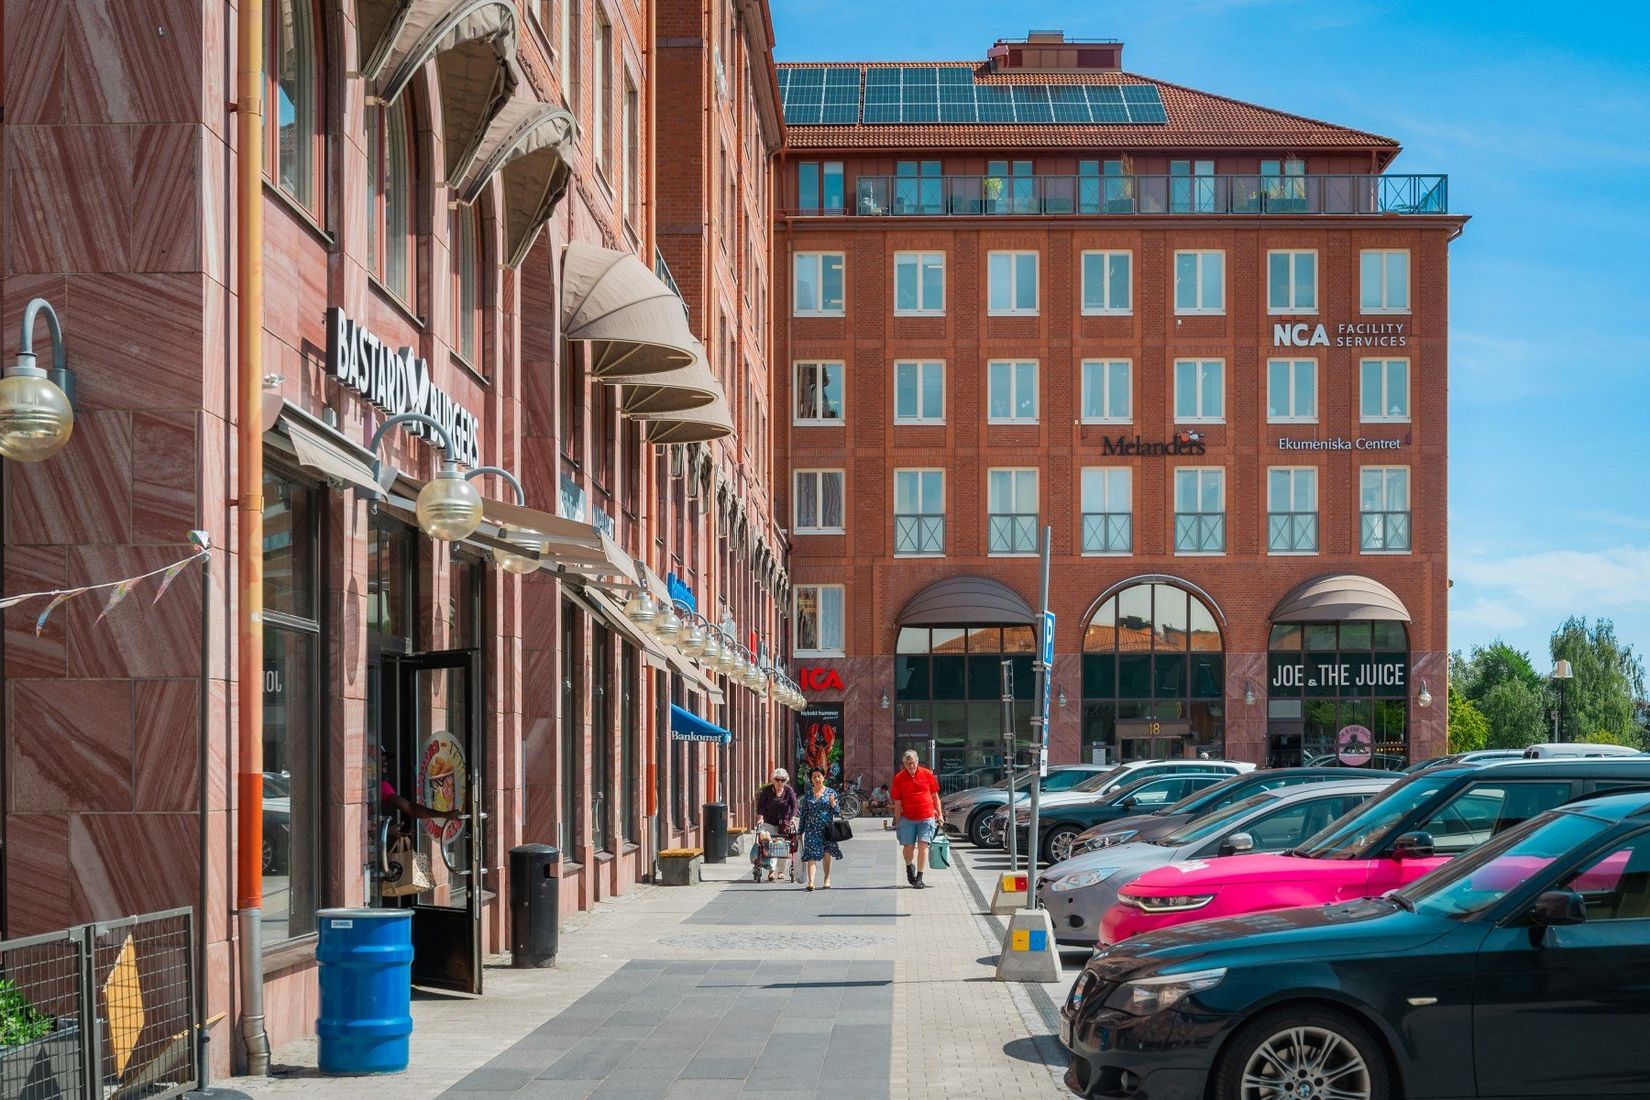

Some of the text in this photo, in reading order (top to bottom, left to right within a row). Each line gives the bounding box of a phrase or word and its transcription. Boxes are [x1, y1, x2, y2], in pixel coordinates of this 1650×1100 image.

[1273, 323, 1330, 347] NCA
[1338, 323, 1404, 334] FACILITY
[1337, 336, 1406, 347] SERVICES
[337, 306, 480, 469] BASTARD BURGERS
[1101, 435, 1206, 456] Melanders
[1279, 437, 1401, 450] Ekumeniska Centret
[1046, 617, 1053, 659] P
[800, 667, 844, 692] ICA
[1272, 664, 1304, 686] JOE
[1318, 664, 1350, 686] THE
[1355, 664, 1405, 686] JUICE
[671, 730, 722, 742] Bankomat
[1148, 722, 1160, 735] 18
